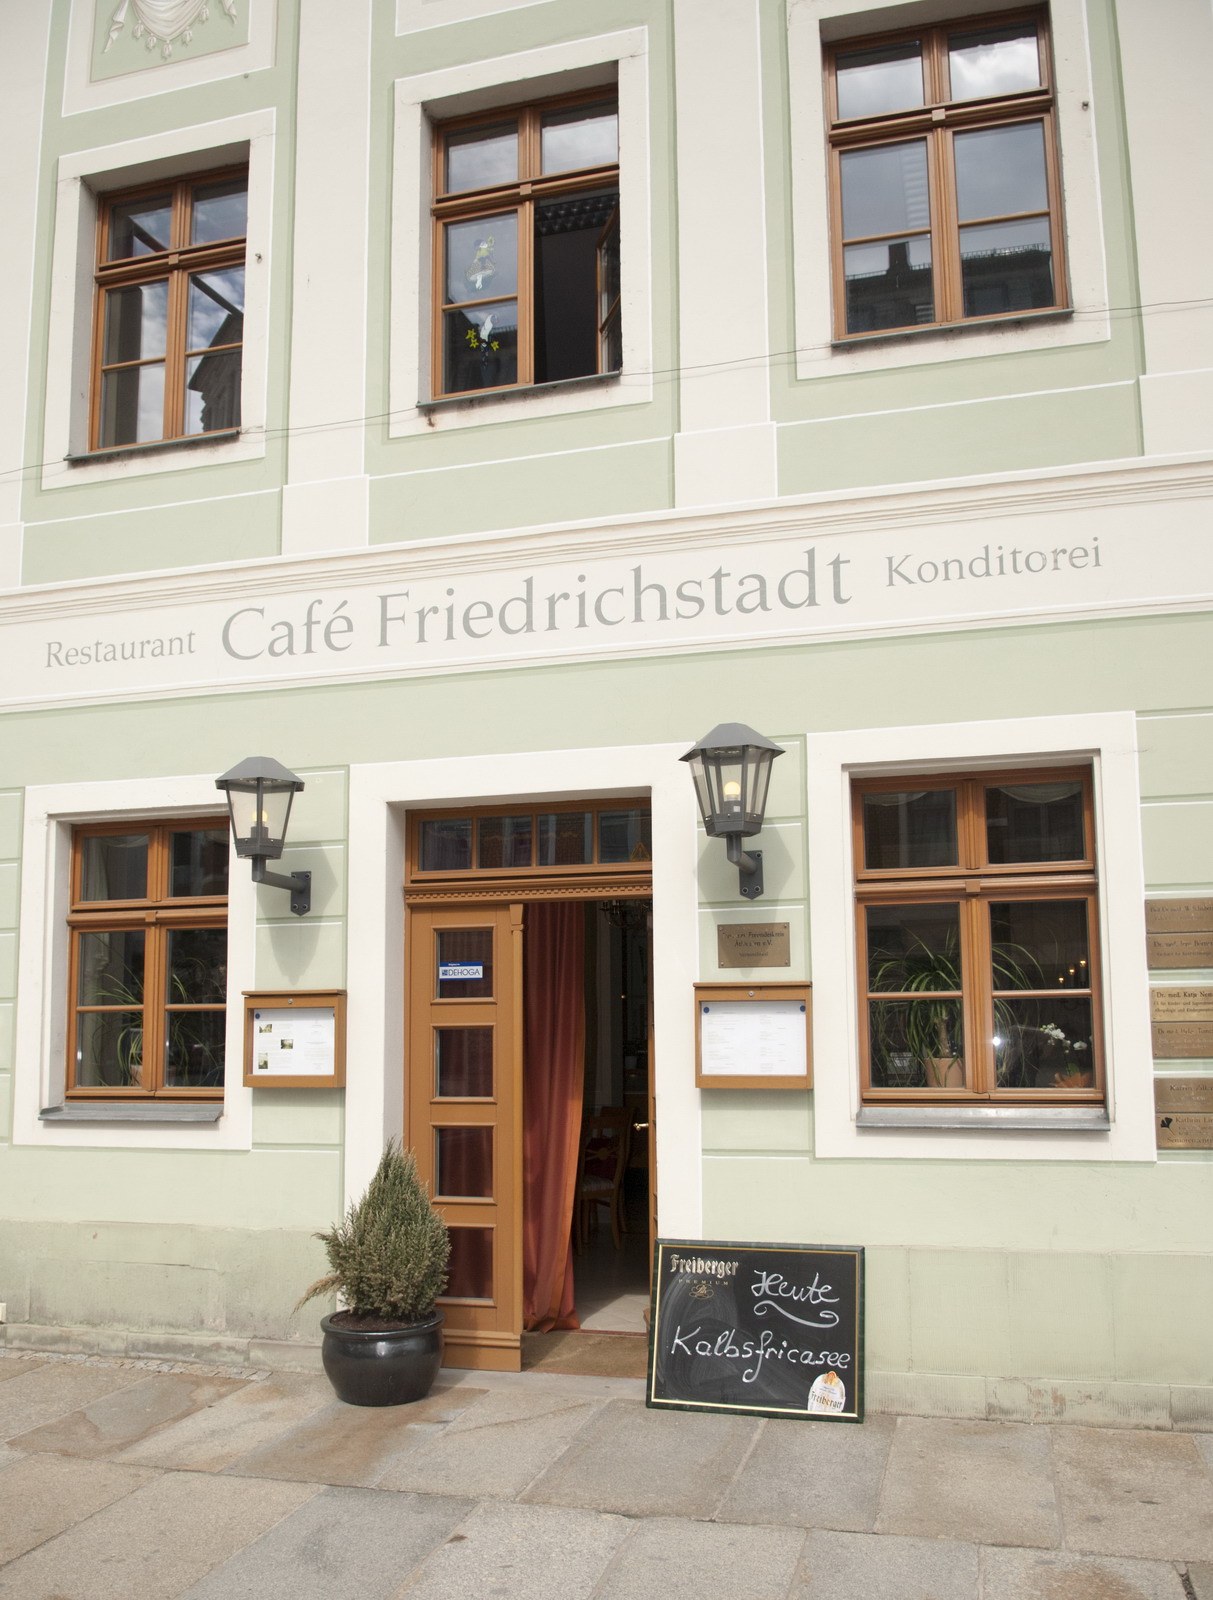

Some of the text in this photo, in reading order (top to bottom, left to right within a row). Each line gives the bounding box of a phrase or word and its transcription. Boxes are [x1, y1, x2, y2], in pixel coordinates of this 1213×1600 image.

[45, 536, 1103, 668] Restaurant Café Friedrichstadt Konditorei
[448, 968, 480, 976] DEHOGA
[670, 1253, 739, 1279] Freiberger
[751, 1269, 840, 1304] Heute
[670, 1325, 851, 1383] Kalbsfricasee
